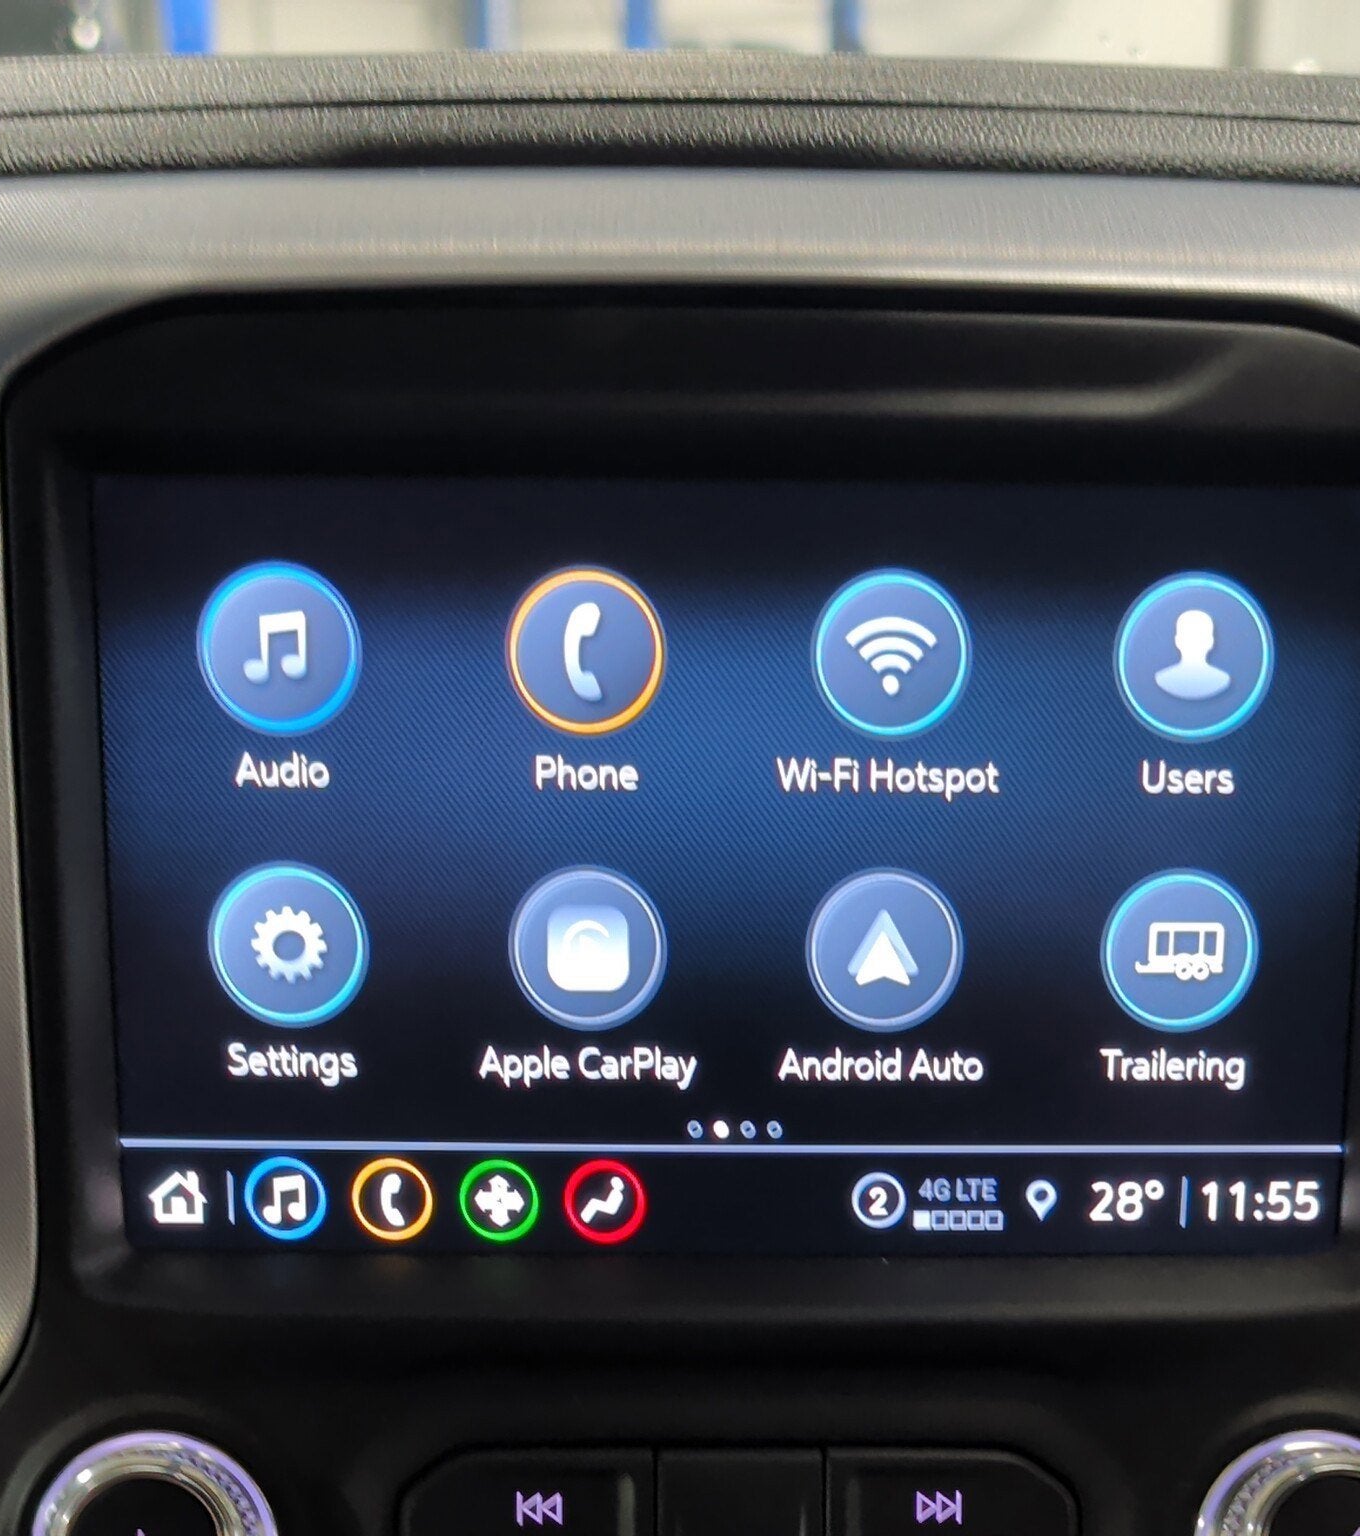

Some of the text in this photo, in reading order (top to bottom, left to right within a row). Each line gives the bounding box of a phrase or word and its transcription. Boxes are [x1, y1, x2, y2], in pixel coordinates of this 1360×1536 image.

[235, 750, 330, 790] Audio
[535, 753, 639, 792] Phone
[776, 756, 1000, 802] Wi-Fi Hotspot
[1141, 759, 1235, 796] Users
[226, 1041, 358, 1088] Settings
[478, 1043, 698, 1091] Apple CarPlay
[777, 1046, 984, 1083] Android Auto
[1099, 1047, 1247, 1091] Trailering
[868, 1177, 1321, 1222] 2 4G LTE 28° 11:55
